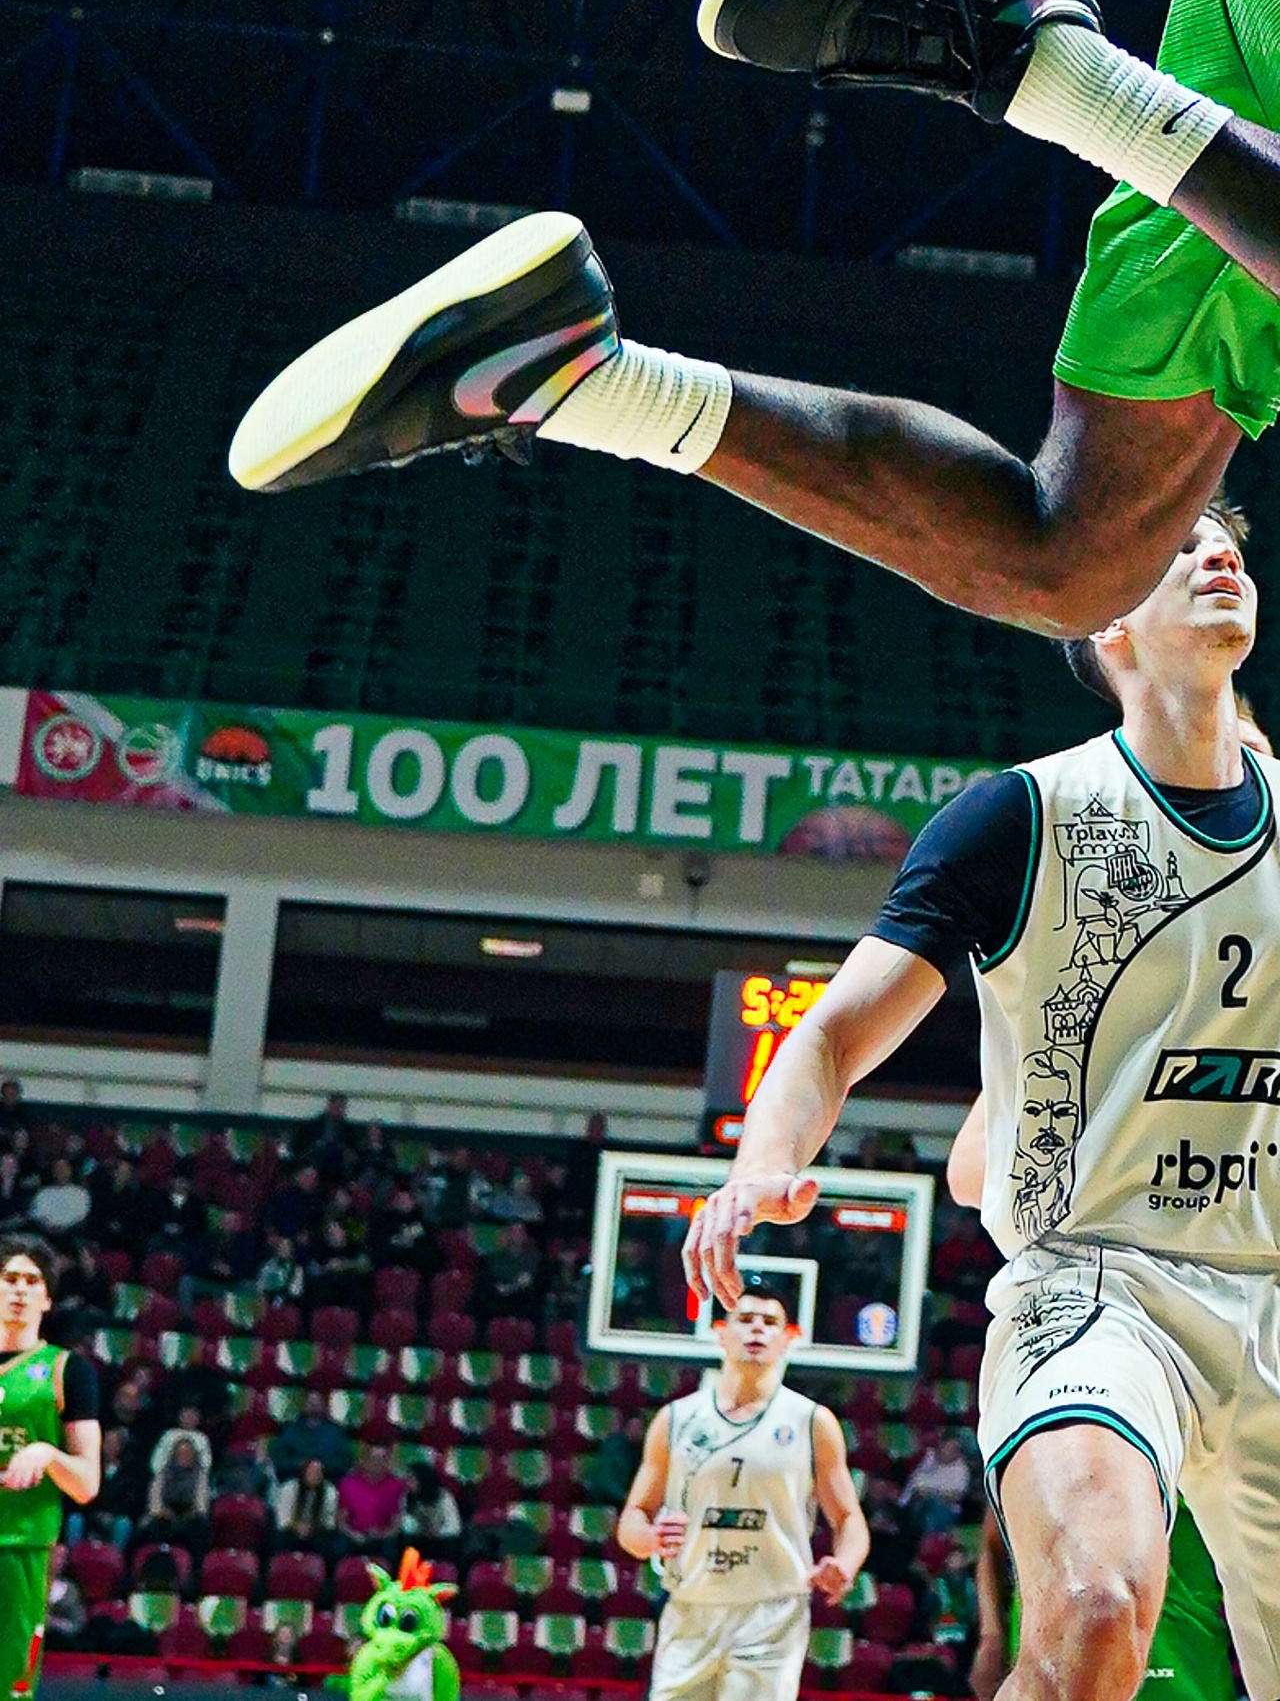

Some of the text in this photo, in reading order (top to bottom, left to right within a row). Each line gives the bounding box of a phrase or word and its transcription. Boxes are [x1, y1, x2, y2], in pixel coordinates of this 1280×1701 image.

[307, 723, 531, 826] 100
[552, 740, 792, 844] ЛЕТ
[1217, 934, 1254, 1009] 2
[1148, 1192, 1211, 1212] group
[731, 1456, 744, 1488] 7
